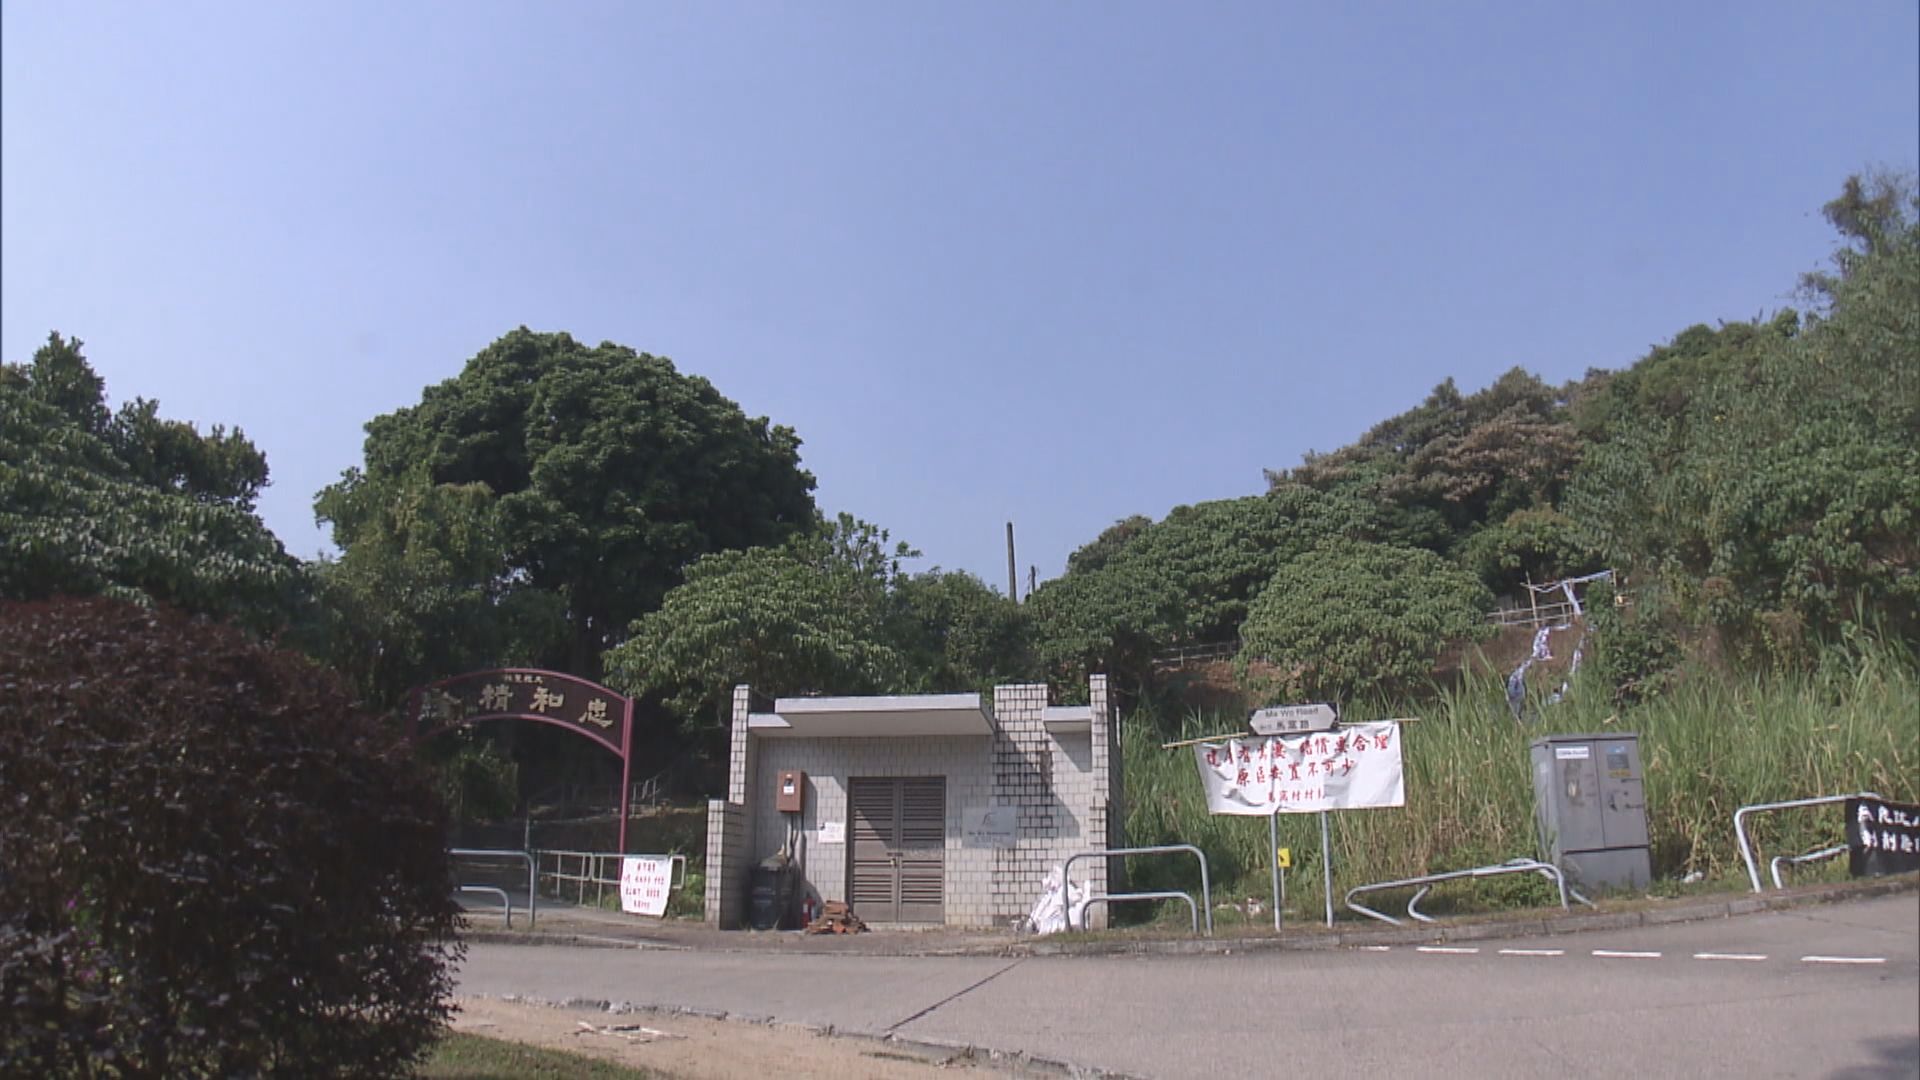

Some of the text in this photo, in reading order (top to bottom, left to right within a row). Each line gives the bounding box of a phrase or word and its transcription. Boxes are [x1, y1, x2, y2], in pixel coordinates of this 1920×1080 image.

[1264, 707, 1319, 718] Ma Wo Road
[1236, 757, 1356, 787] 原區安置不可少
